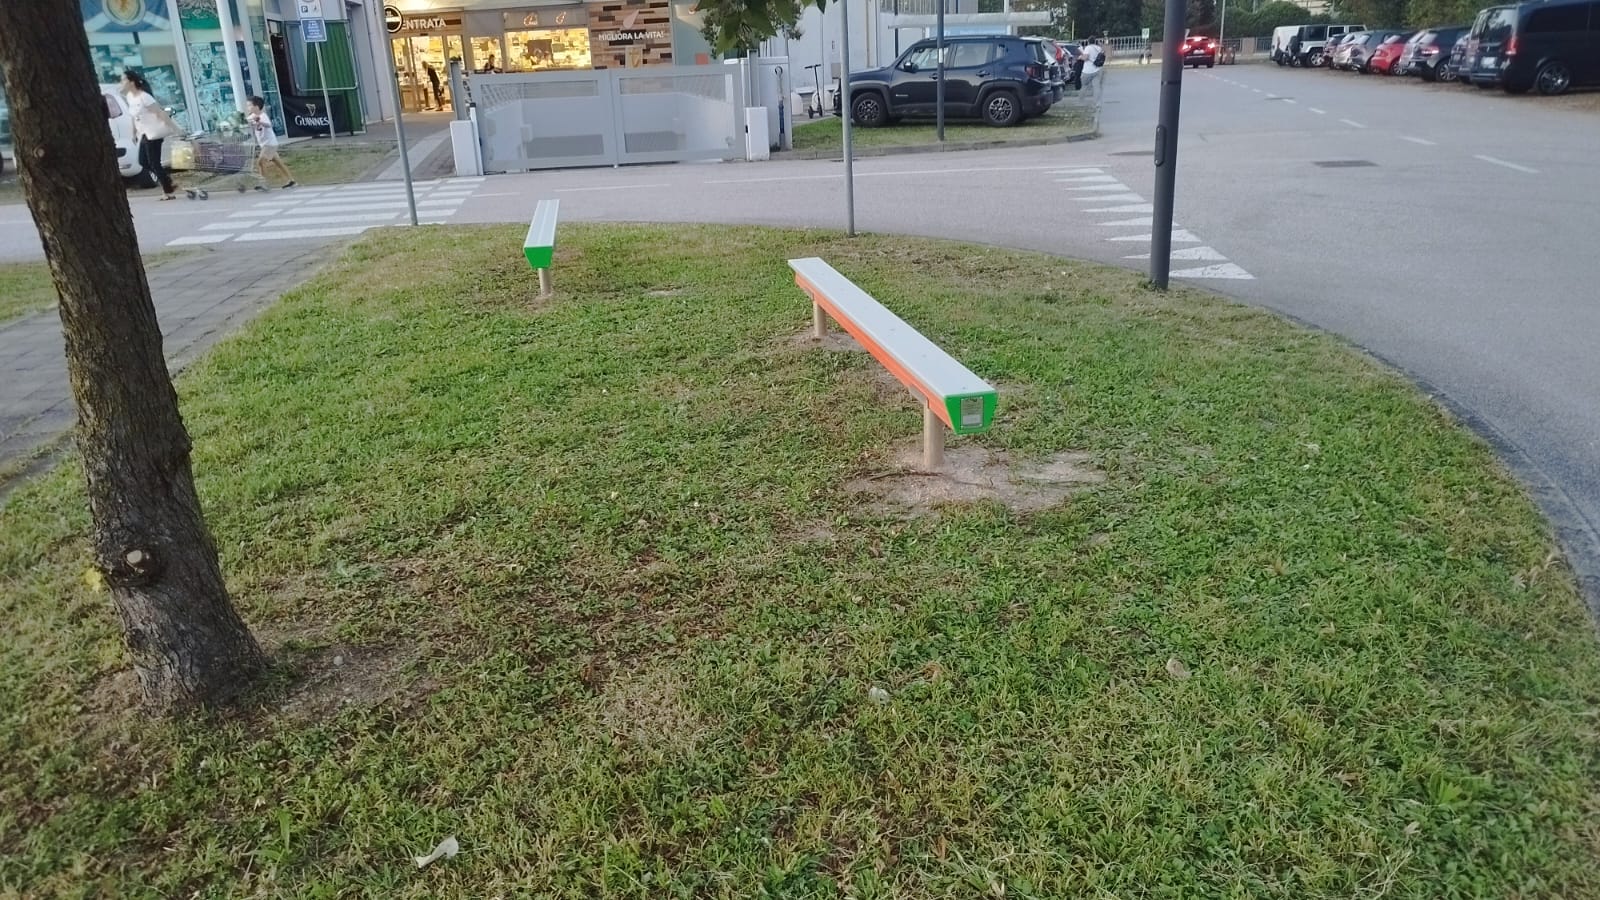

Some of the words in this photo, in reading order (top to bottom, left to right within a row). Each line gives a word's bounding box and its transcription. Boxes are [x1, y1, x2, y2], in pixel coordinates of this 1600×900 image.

[598, 32, 633, 41] MIGLIORA
[634, 32, 644, 40] LA
[645, 31, 664, 39] VITA!
[294, 115, 331, 127] GUINNES
